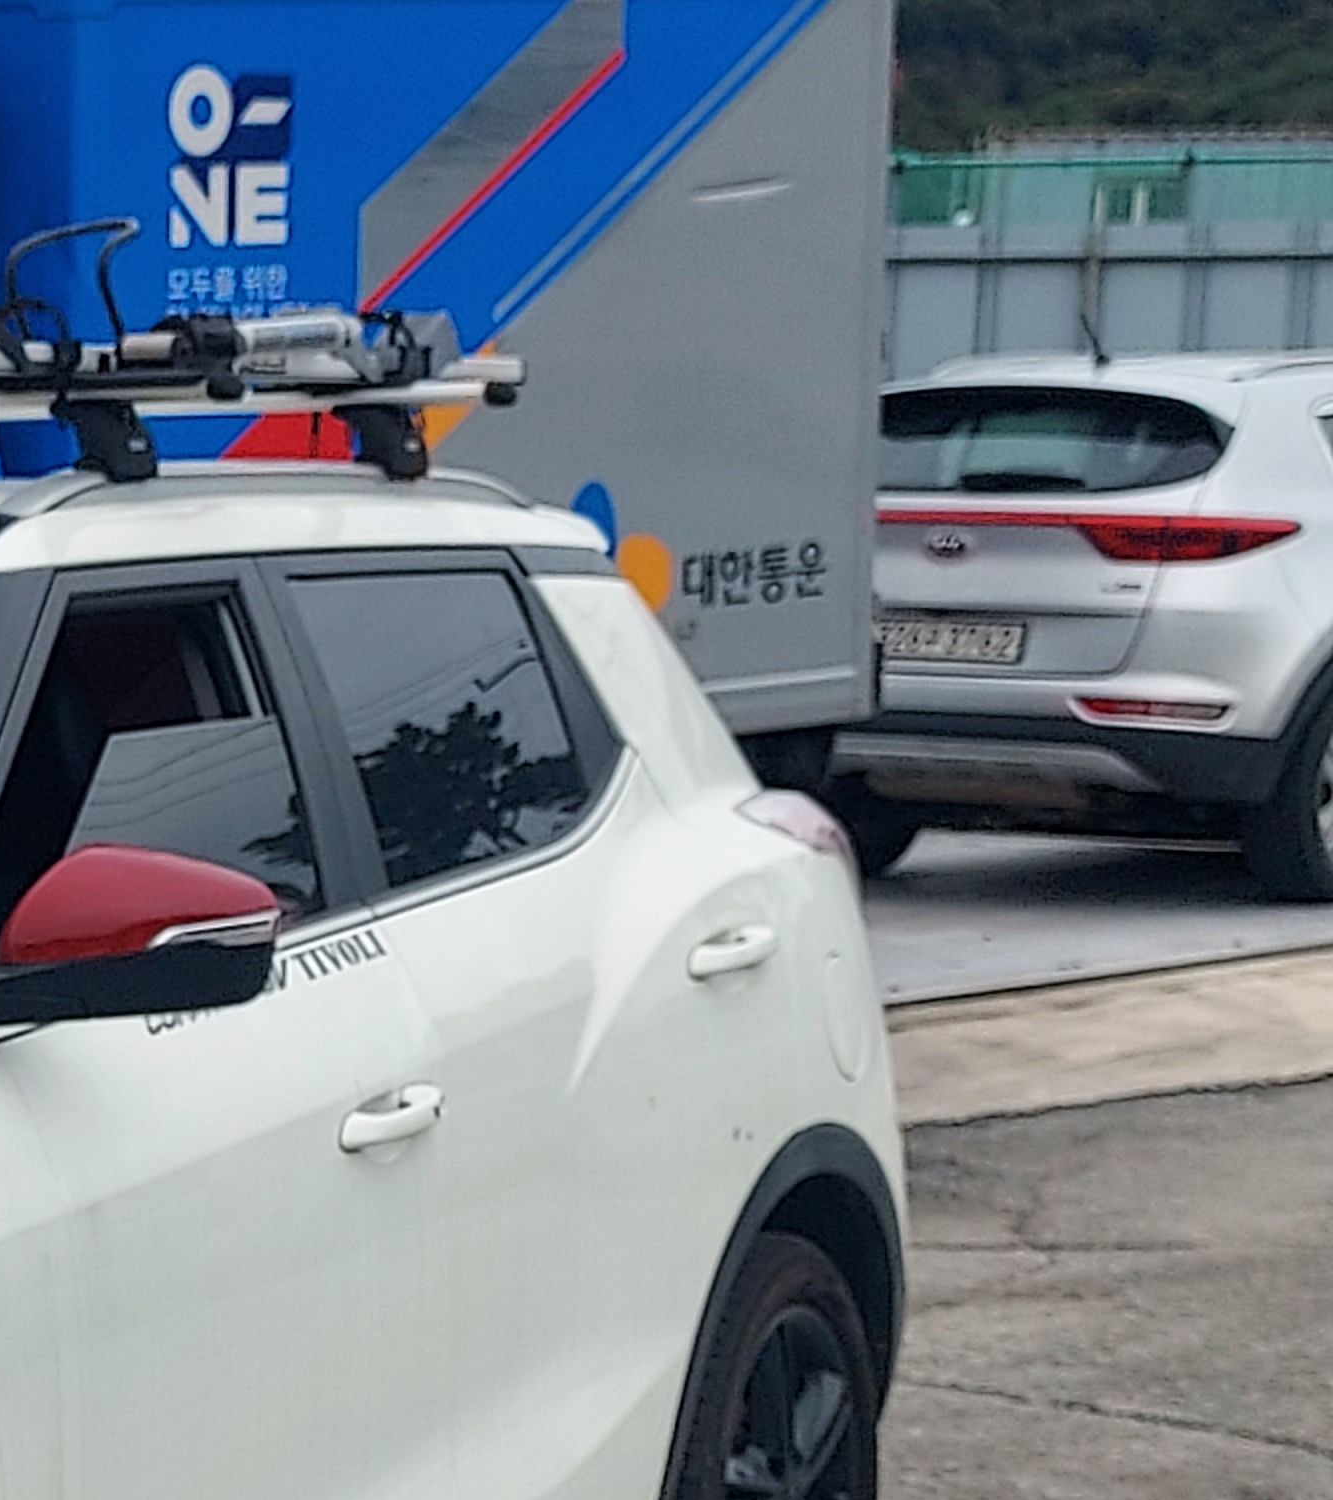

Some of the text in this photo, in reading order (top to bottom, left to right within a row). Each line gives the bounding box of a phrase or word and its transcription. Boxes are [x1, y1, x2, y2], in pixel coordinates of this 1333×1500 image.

[167, 265, 288, 303] 모두를 위한
[682, 542, 826, 607] 대한통운
[294, 930, 387, 981] TIVOLI
